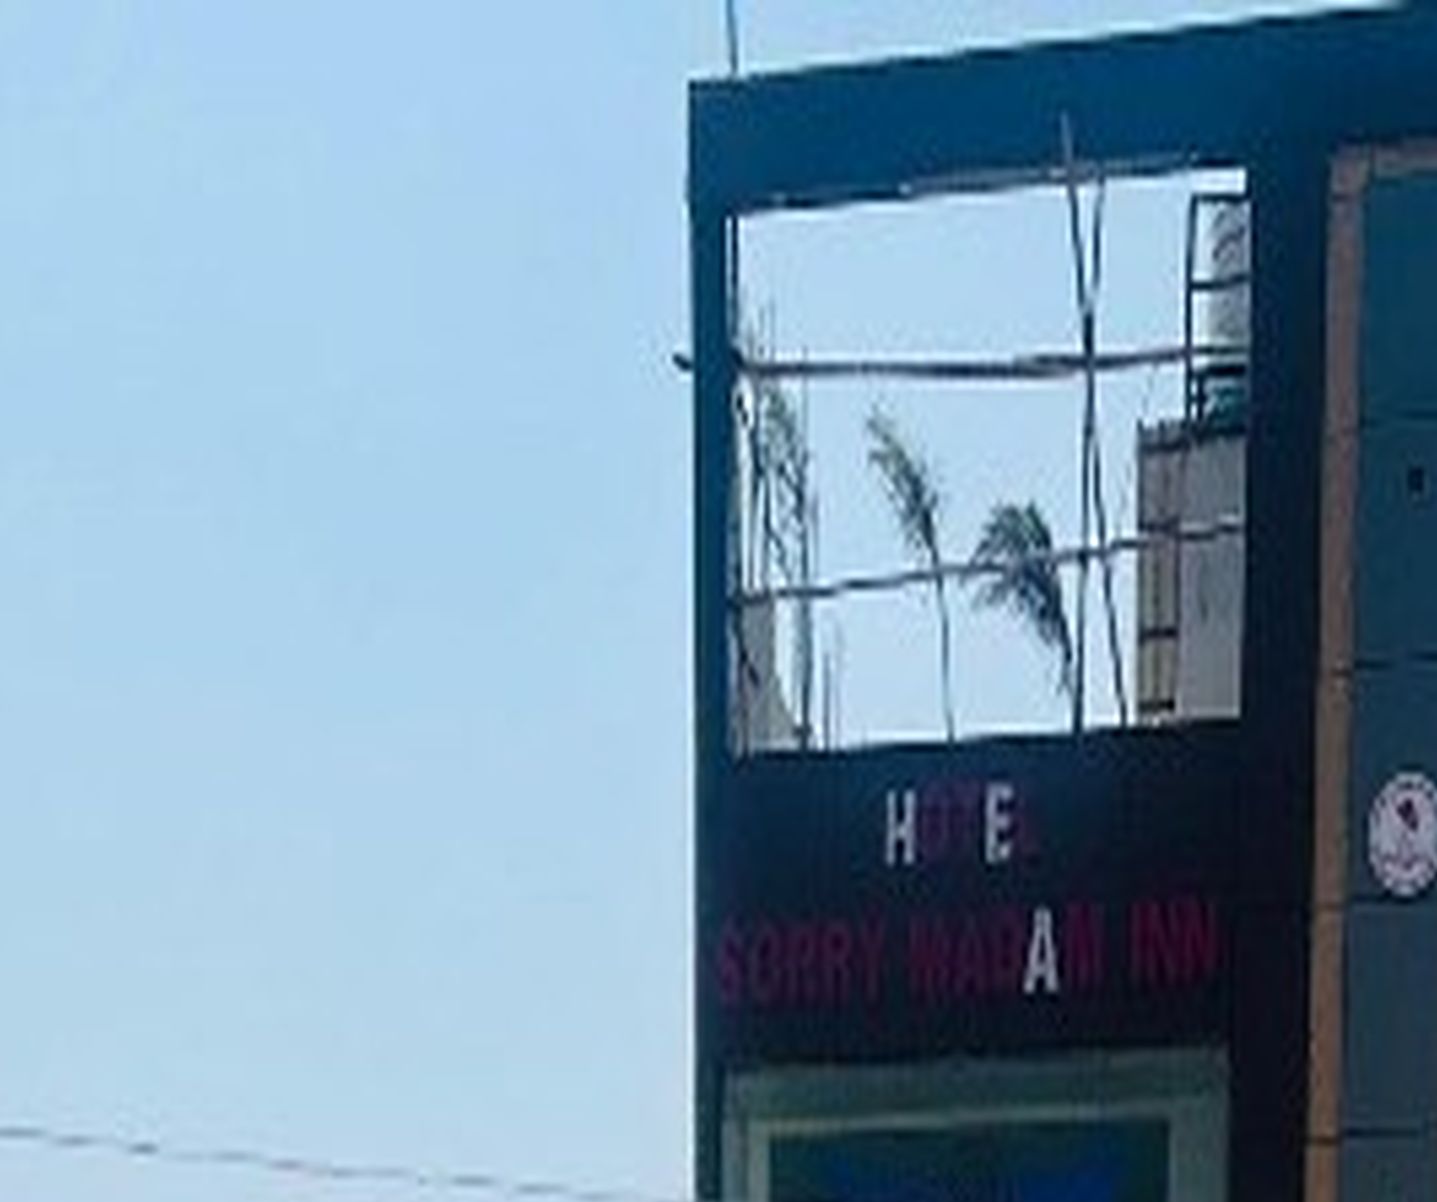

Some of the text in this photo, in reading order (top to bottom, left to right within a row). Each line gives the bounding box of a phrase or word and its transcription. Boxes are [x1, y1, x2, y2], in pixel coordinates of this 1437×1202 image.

[717, 896, 1218, 1008] SORRY MADAM INN
